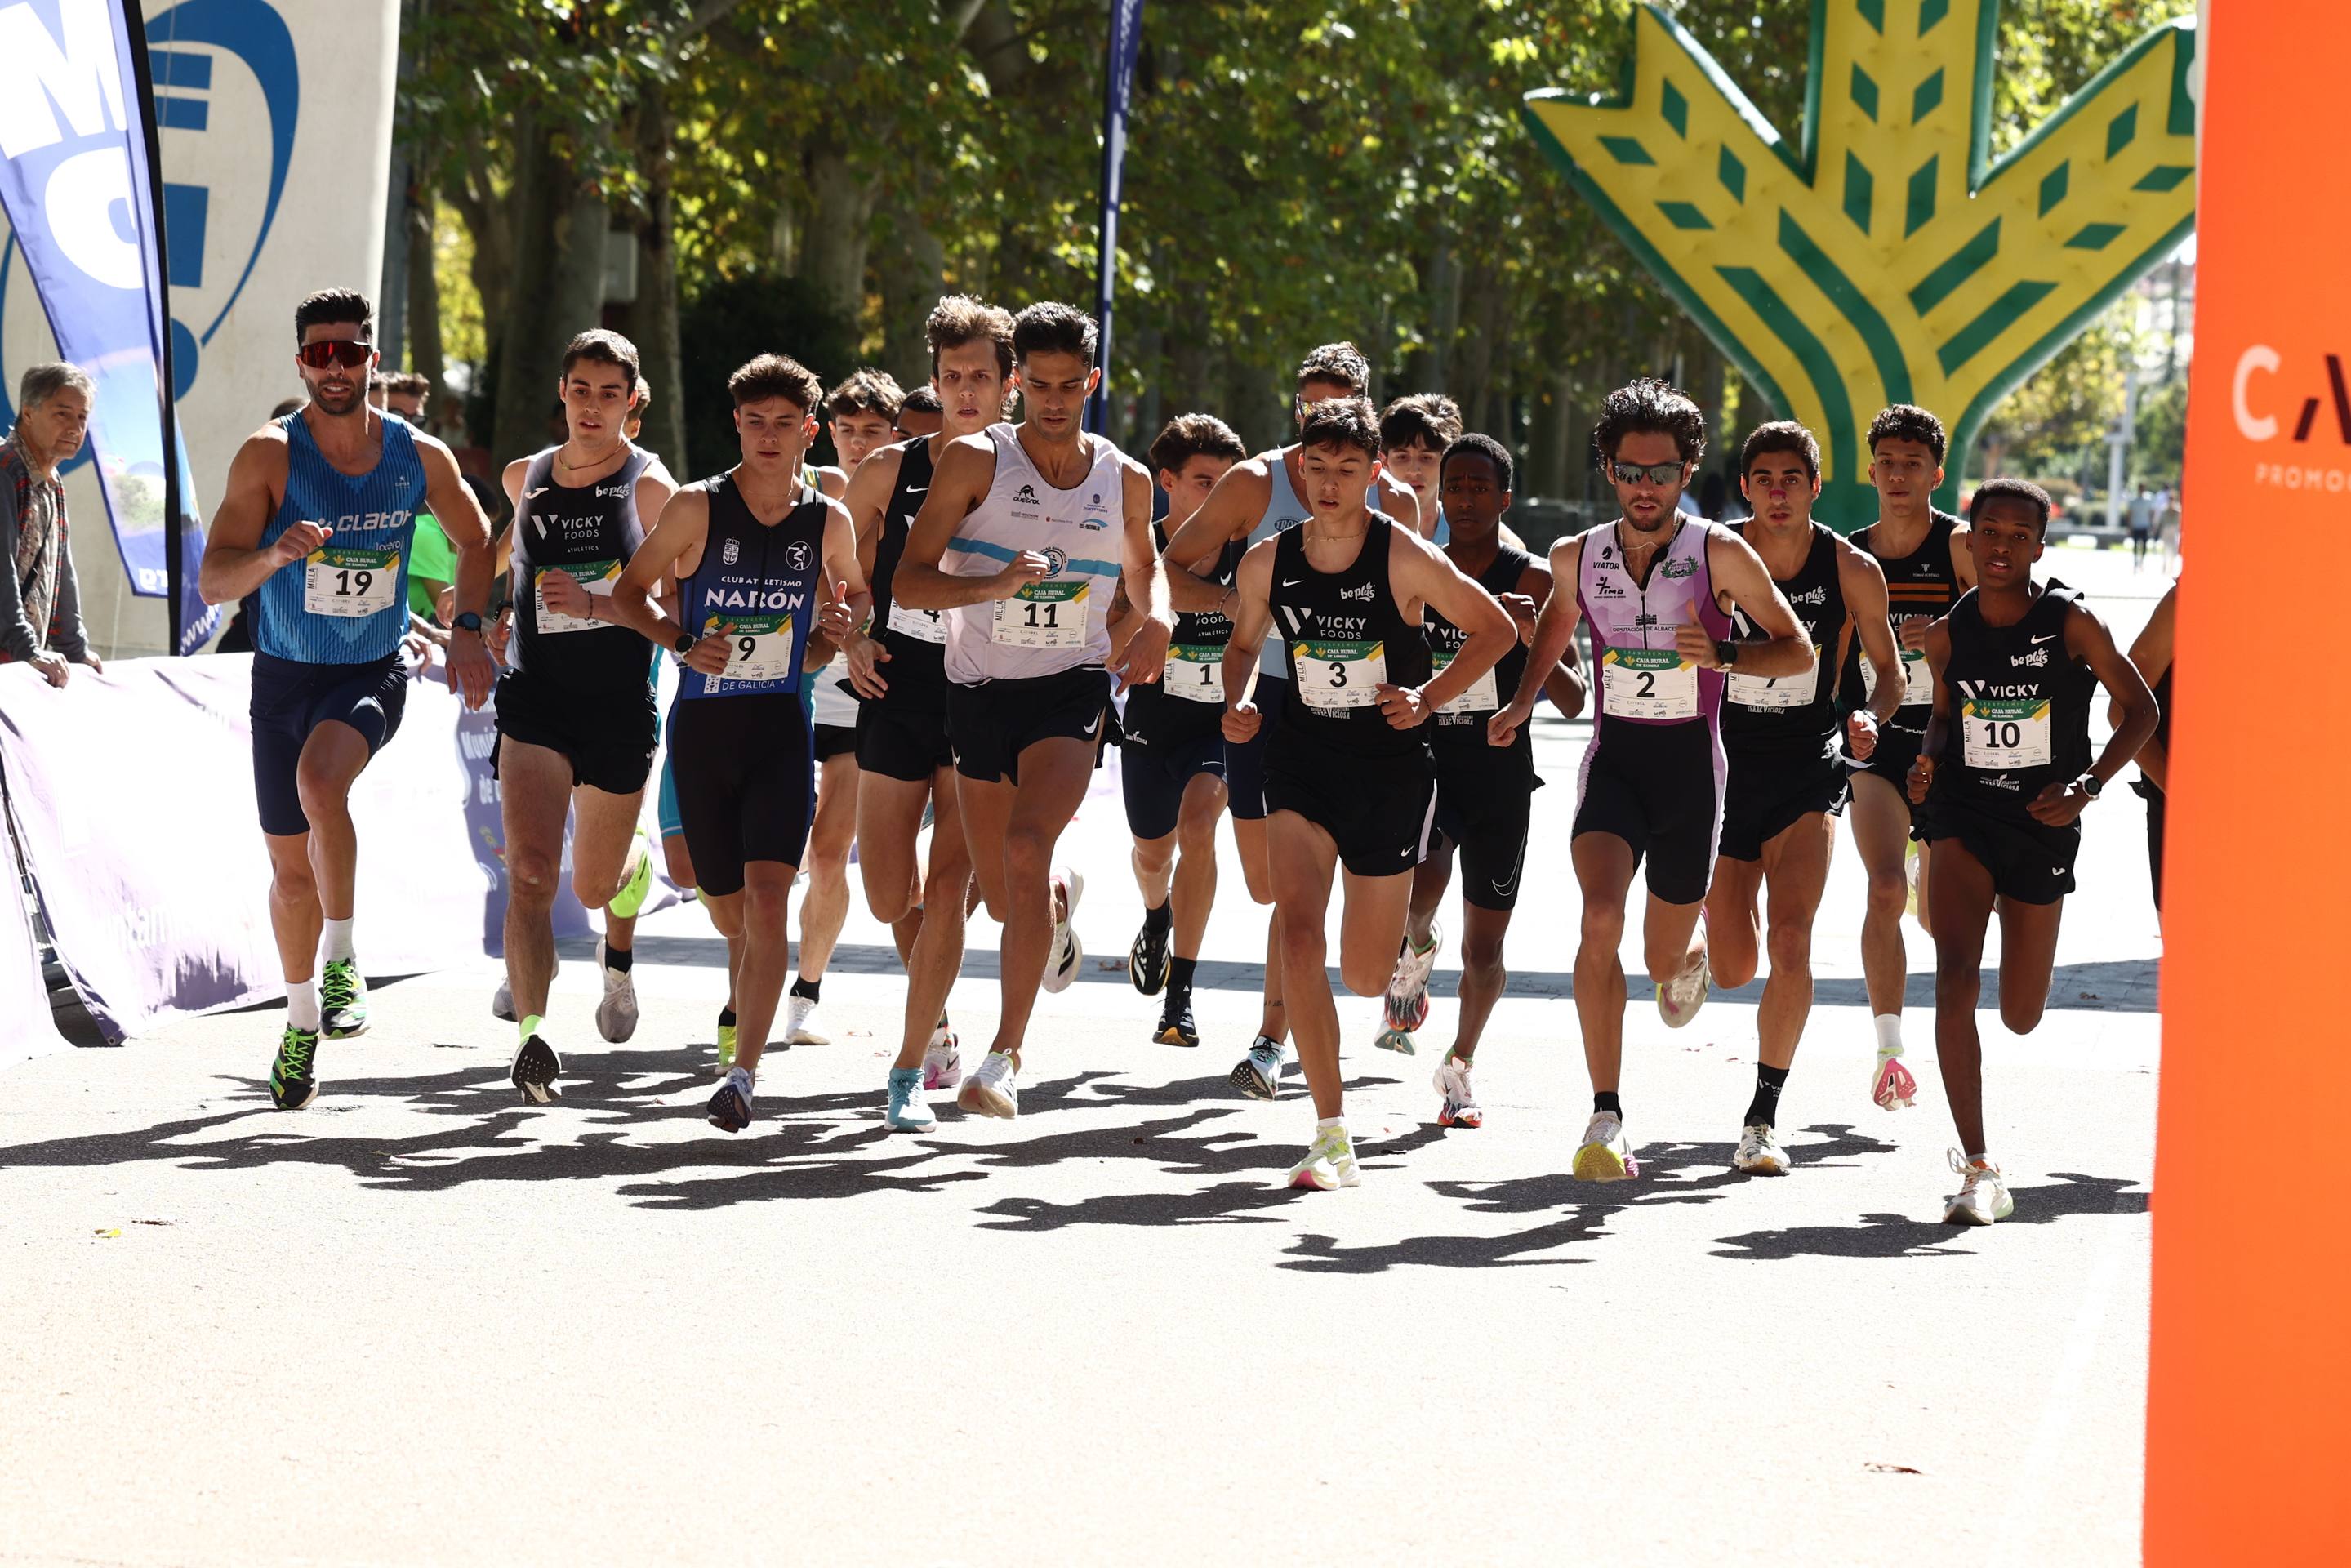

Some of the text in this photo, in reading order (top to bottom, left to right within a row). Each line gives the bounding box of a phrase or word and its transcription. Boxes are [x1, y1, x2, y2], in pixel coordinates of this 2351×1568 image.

[2255, 463, 2351, 492] PROMO
[561, 515, 604, 530] VICKY
[564, 529, 599, 540] FOODS
[567, 546, 599, 554] ATHLETICS
[1593, 561, 1619, 570] VIATOR
[307, 568, 315, 590] MILLA
[336, 570, 372, 596] 19
[721, 576, 744, 584] CLUB
[705, 587, 806, 610] NARÓN
[1340, 582, 1375, 602] be plus
[1790, 586, 1826, 605] be plus
[995, 600, 1004, 621] MILLA
[1024, 603, 1058, 628] 11
[1316, 615, 1367, 630] VICKY
[1320, 629, 1362, 640] FOODS
[1440, 628, 1467, 639] VIC
[738, 636, 756, 661] 9
[2010, 648, 2048, 667] be plus
[1200, 664, 1213, 685] 1
[1297, 662, 1305, 682] MILLA
[1329, 662, 1347, 688] 3
[722, 679, 776, 691] DE GALICIA
[1636, 671, 1655, 698] 2
[1989, 684, 2040, 698] VICKY
[1984, 722, 2021, 748] 10
